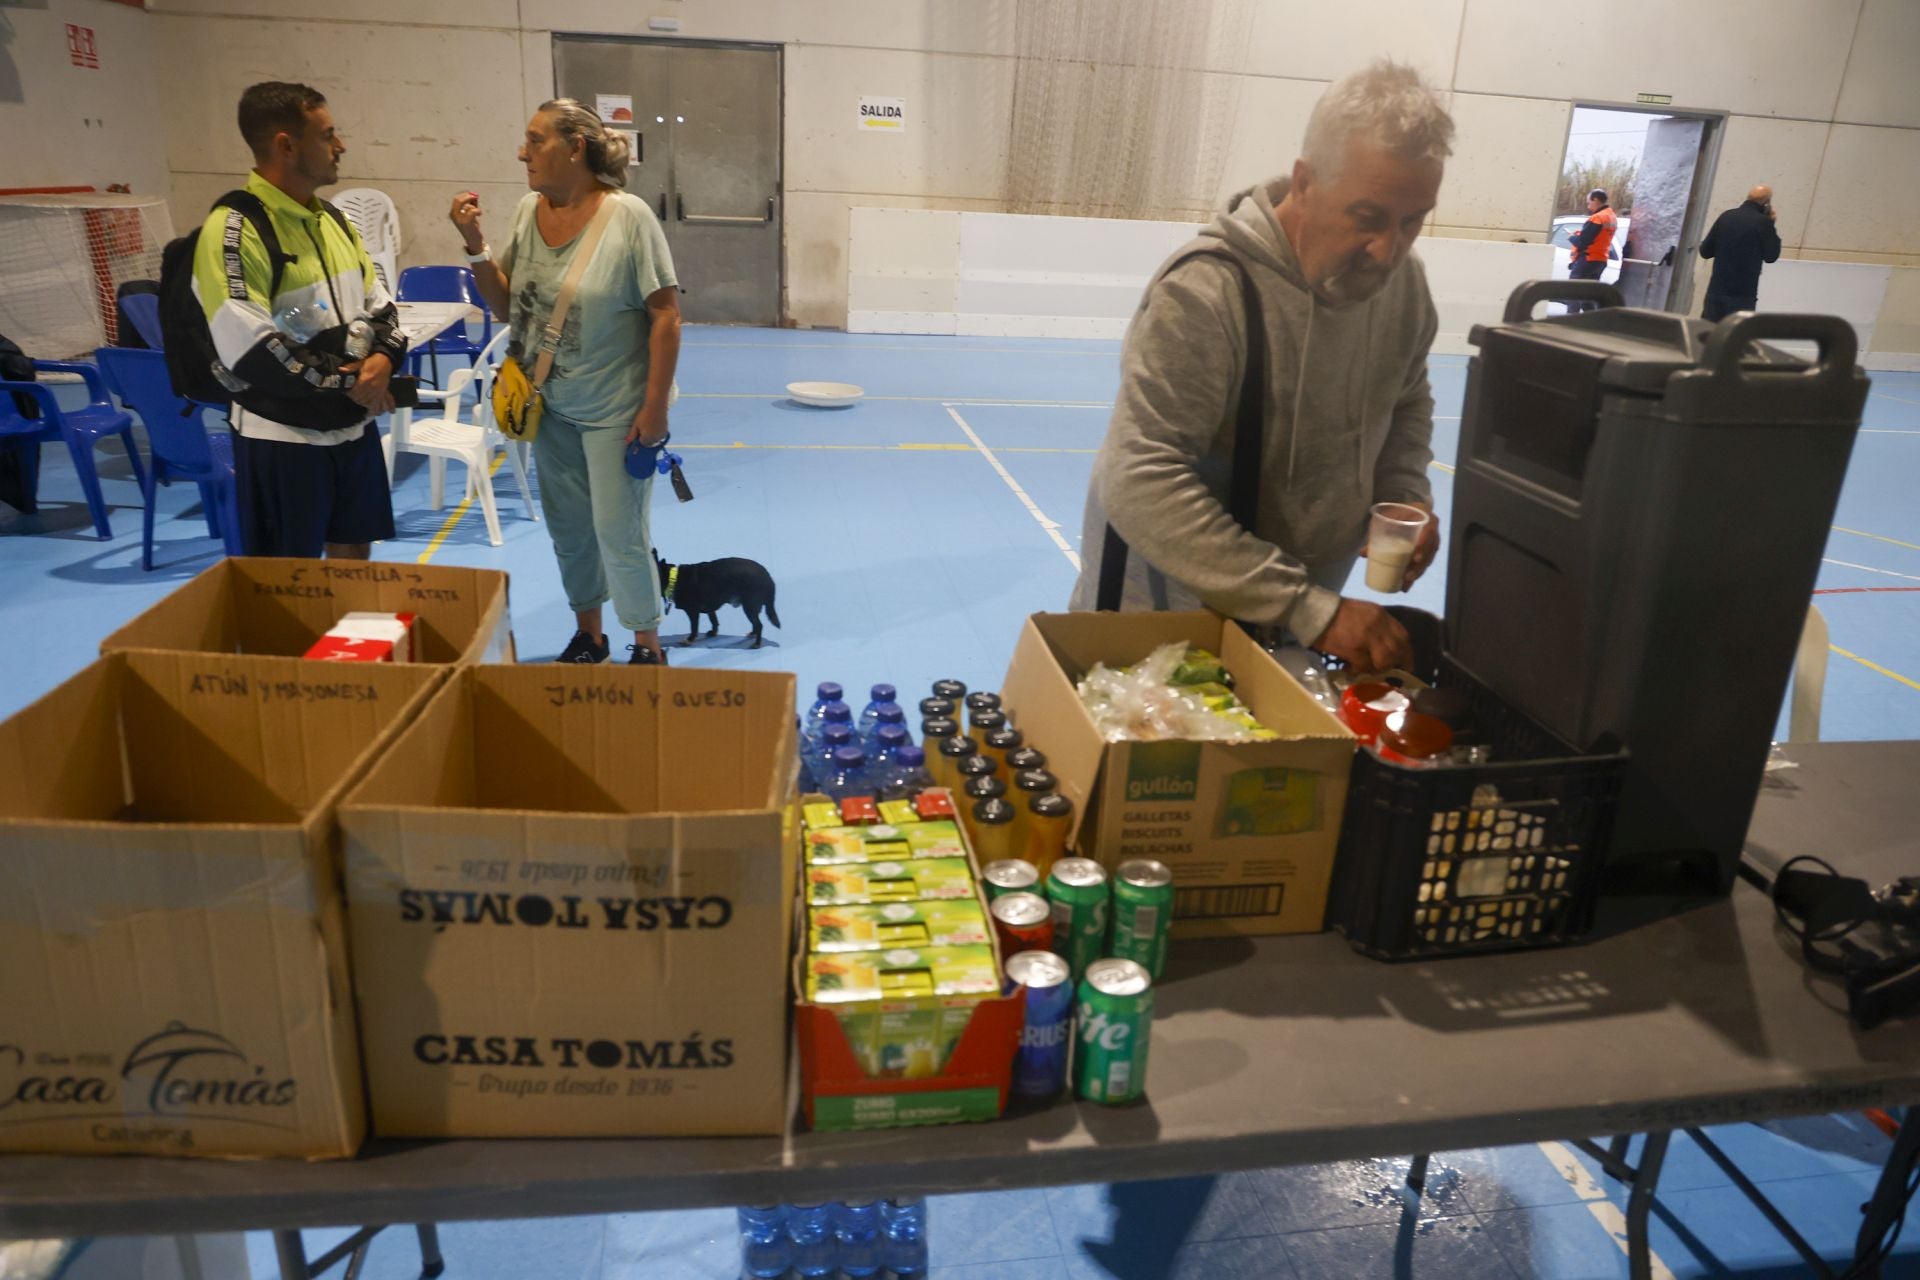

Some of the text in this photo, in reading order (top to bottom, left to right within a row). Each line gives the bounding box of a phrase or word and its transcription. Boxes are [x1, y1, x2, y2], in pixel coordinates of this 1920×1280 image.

[860, 104, 902, 118] SALIDA
[408, 587, 461, 601] PATATA
[544, 683, 635, 707] JAMÓN
[672, 689, 747, 708] QUESO
[1128, 774, 1195, 799] gullón
[1123, 810, 1192, 823] GALLETAS
[1121, 827, 1183, 839] BISCUITS
[518, 861, 588, 886] desde
[597, 895, 733, 931] CASA
[413, 1030, 735, 1070] CASA TOMÁS
[122, 1046, 297, 1114] Tomás
[478, 1072, 548, 1099] Grupo
[553, 1075, 619, 1097] desde
